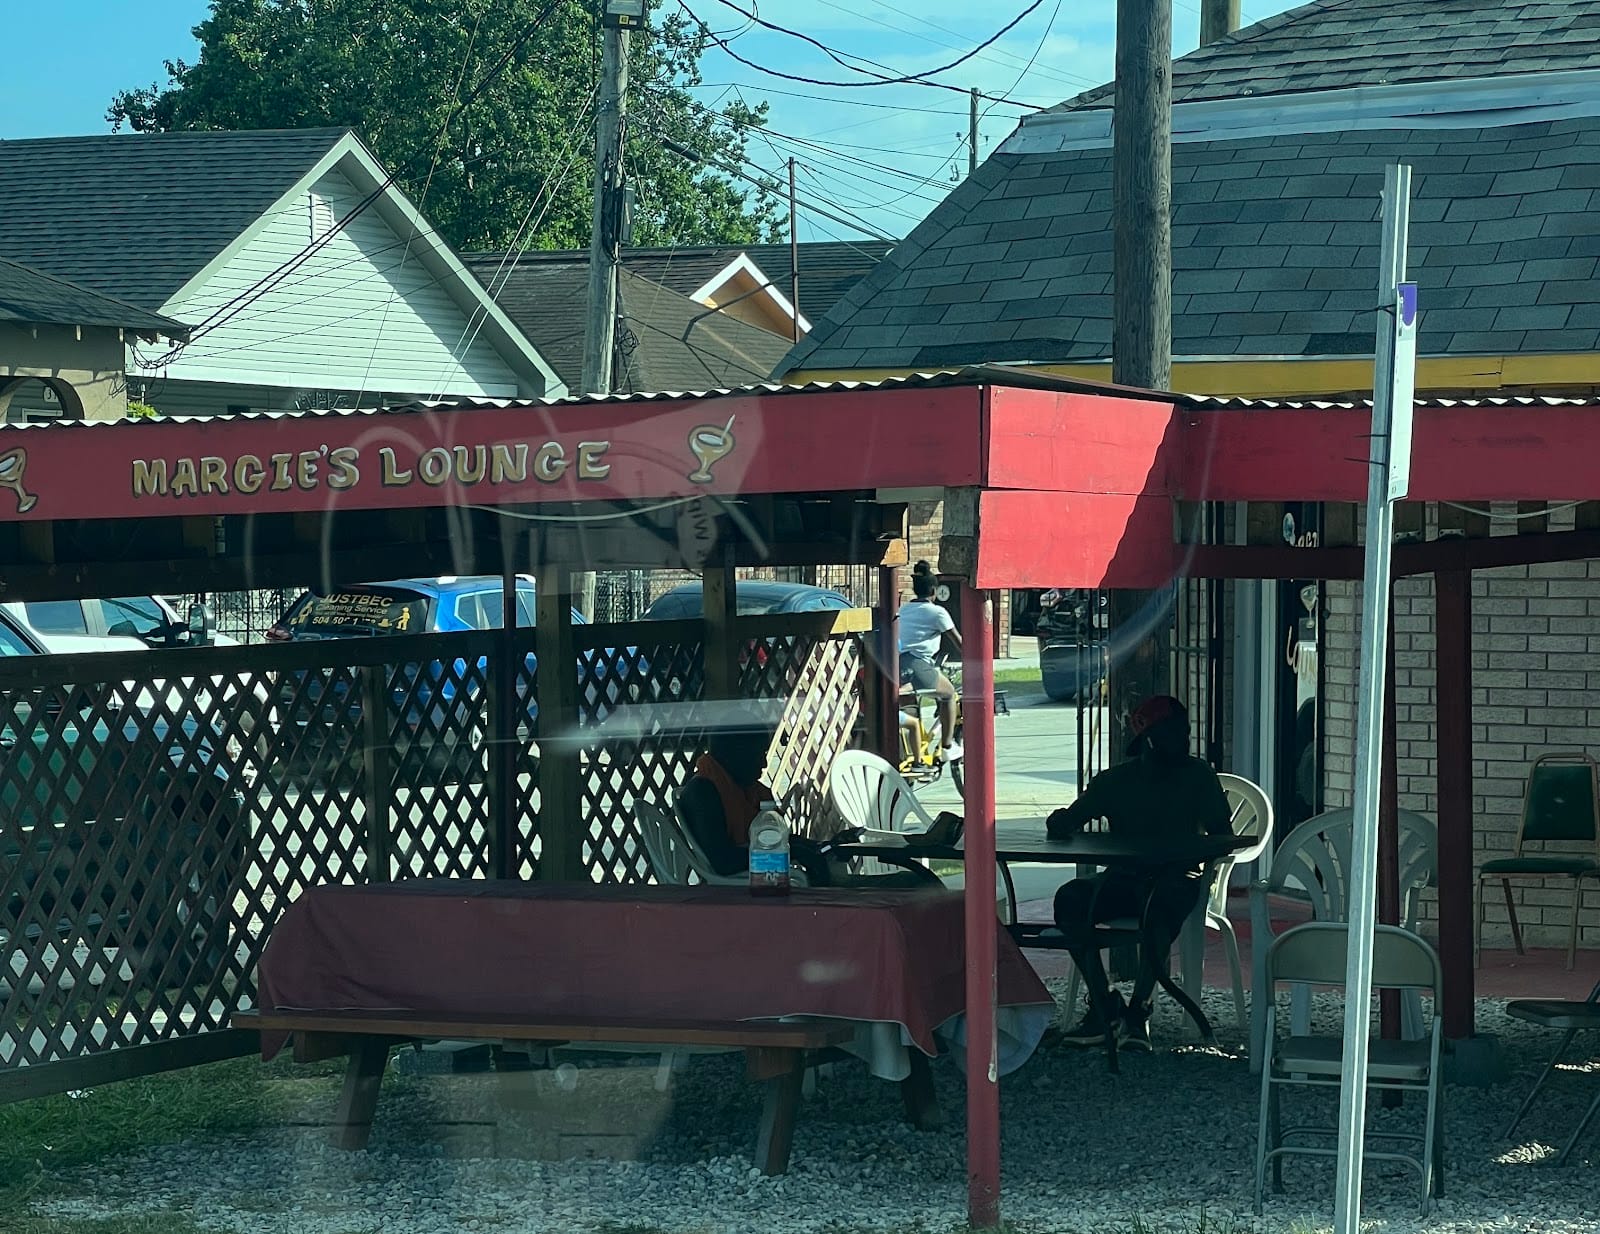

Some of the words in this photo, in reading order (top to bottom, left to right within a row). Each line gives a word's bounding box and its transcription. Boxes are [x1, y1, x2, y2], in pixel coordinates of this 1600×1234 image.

[132, 444, 360, 498] MARGIE'S
[379, 441, 610, 487] LOUNGE
[319, 594, 393, 606] JUSTBEC
[315, 604, 353, 613] Cleaning
[354, 605, 388, 615] Service
[312, 617, 330, 625] 504
